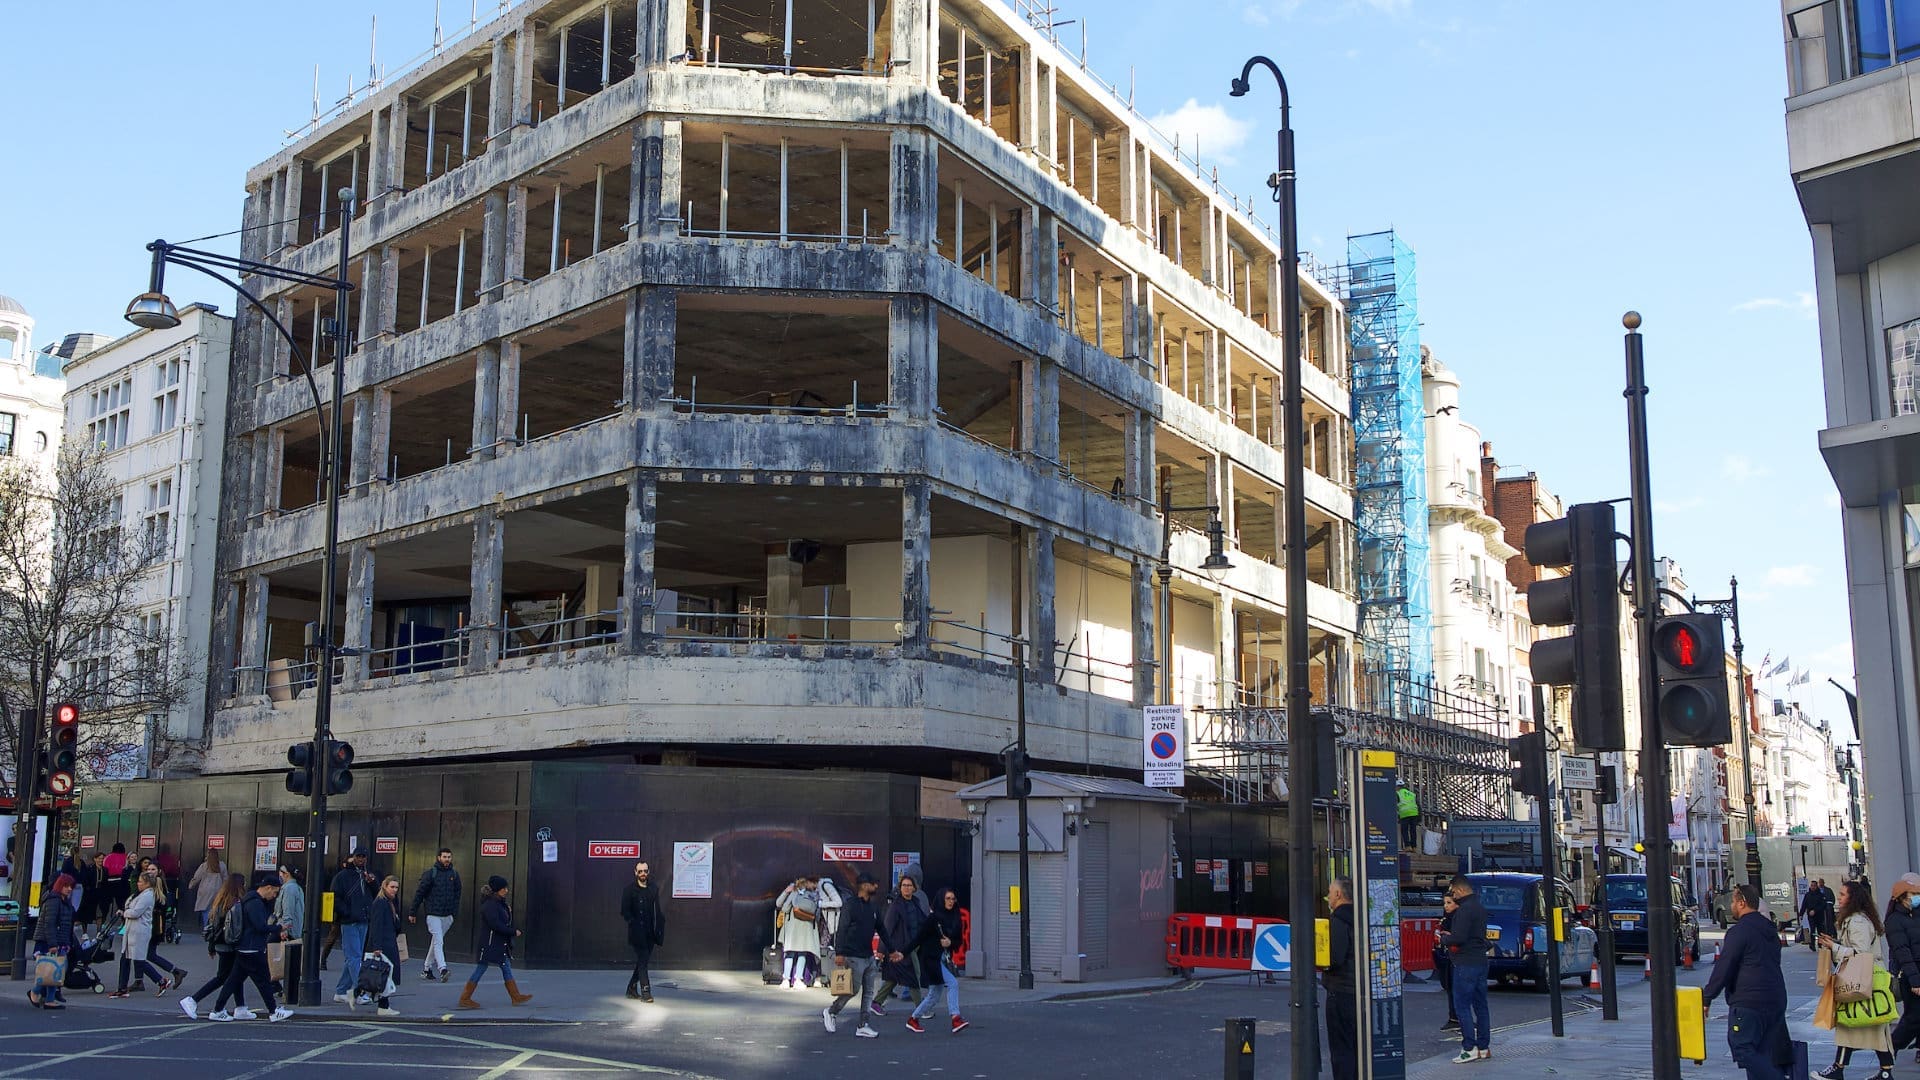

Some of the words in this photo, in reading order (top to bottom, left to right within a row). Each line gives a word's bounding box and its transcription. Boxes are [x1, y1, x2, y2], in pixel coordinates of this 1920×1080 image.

[1151, 722, 1176, 730] ZONE
[1157, 761, 1182, 769] loading
[1565, 760, 1574, 768] NEW
[1575, 761, 1587, 769] BOND
[1565, 768, 1580, 776] STREET
[378, 842, 396, 850] O'KEEFE
[484, 845, 504, 853] O'KEEFE
[594, 846, 635, 854] O'KEEFE
[833, 849, 868, 858] 'KEEFE
